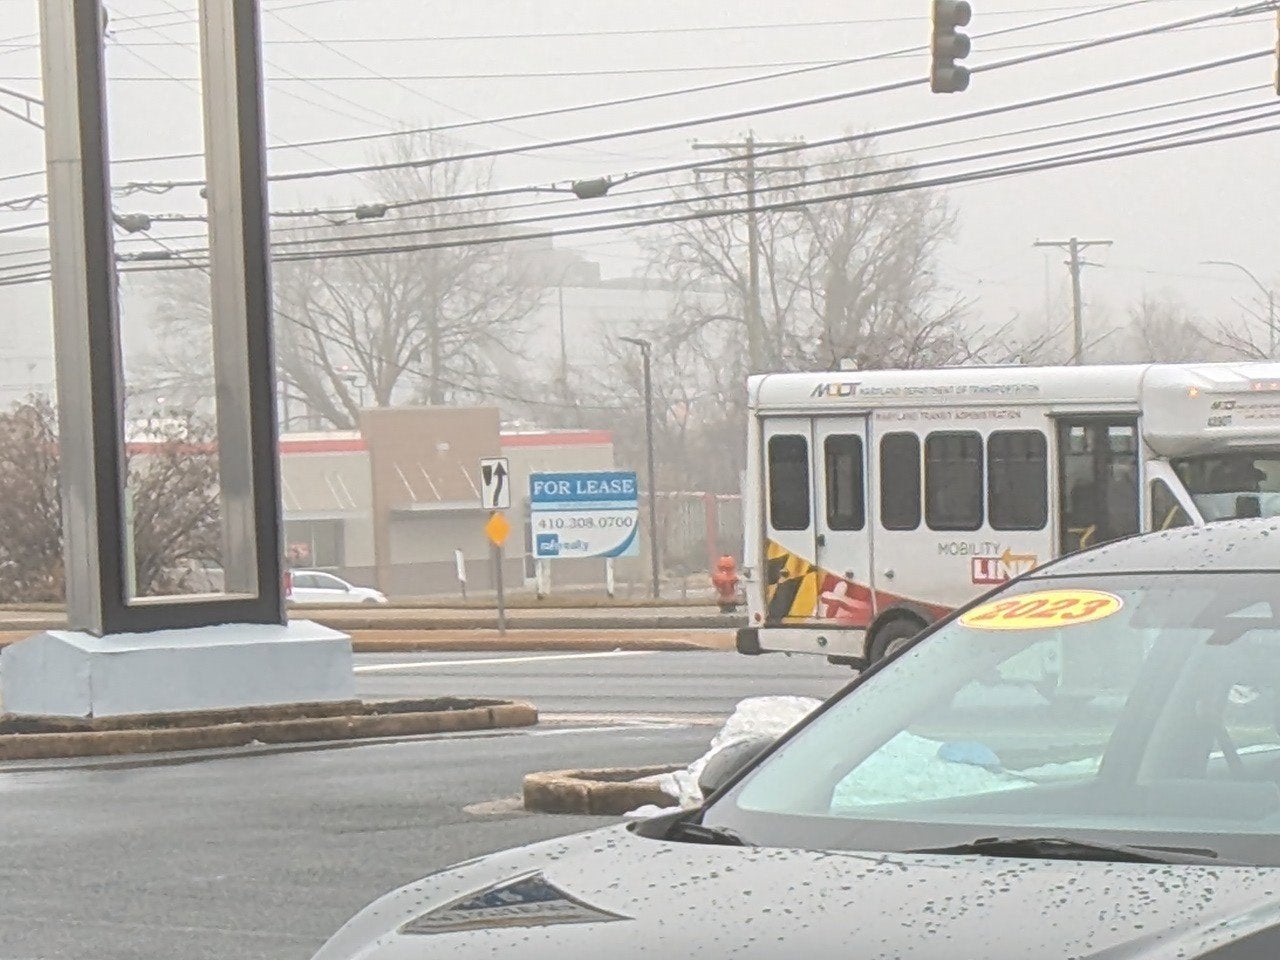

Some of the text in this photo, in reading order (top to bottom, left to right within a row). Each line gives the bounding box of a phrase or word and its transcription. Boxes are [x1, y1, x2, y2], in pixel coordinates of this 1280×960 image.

[533, 480, 635, 496] FOR LEASE
[938, 541, 1000, 555] MOBILITY
[969, 598, 1111, 622] 2023
